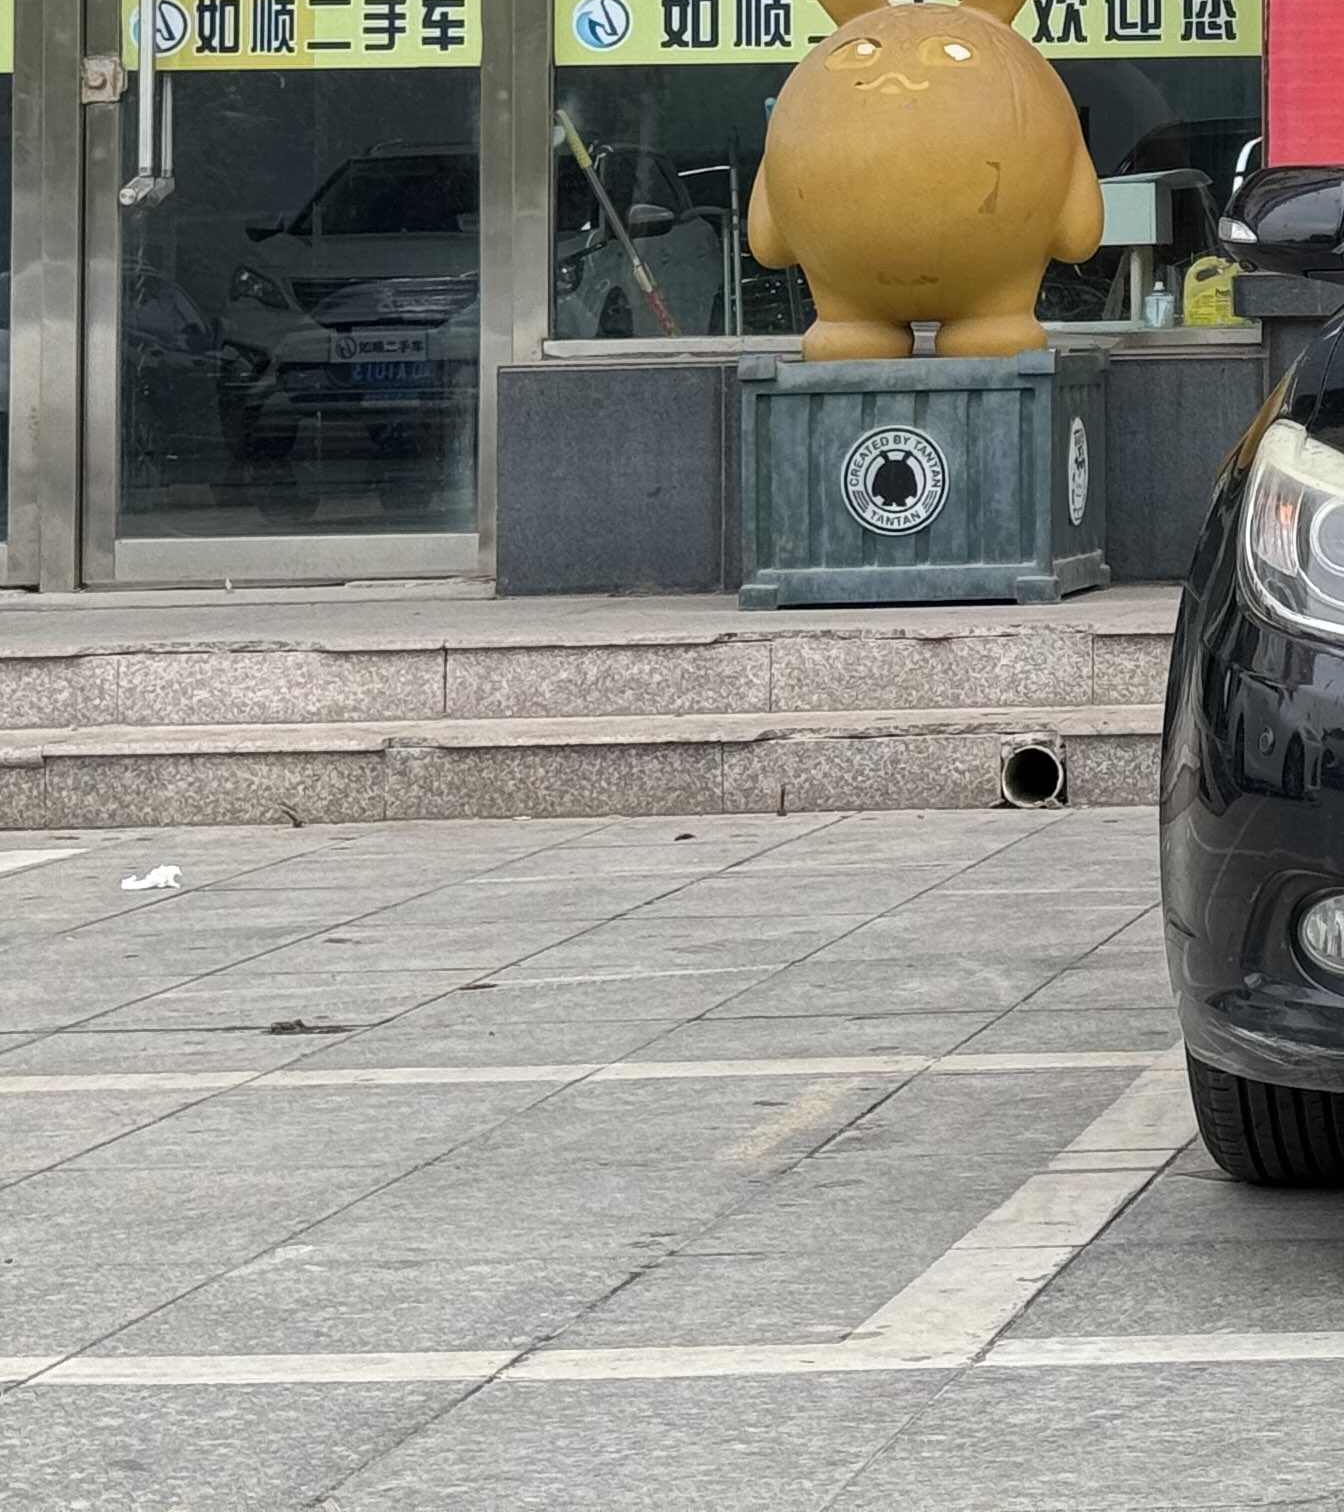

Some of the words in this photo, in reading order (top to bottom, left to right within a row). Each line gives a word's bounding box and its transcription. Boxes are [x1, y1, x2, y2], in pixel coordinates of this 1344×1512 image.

[849, 436, 890, 488] CREATED
[892, 434, 912, 445] BY
[913, 440, 942, 489] TANTAN
[870, 509, 922, 527] TANTAN
